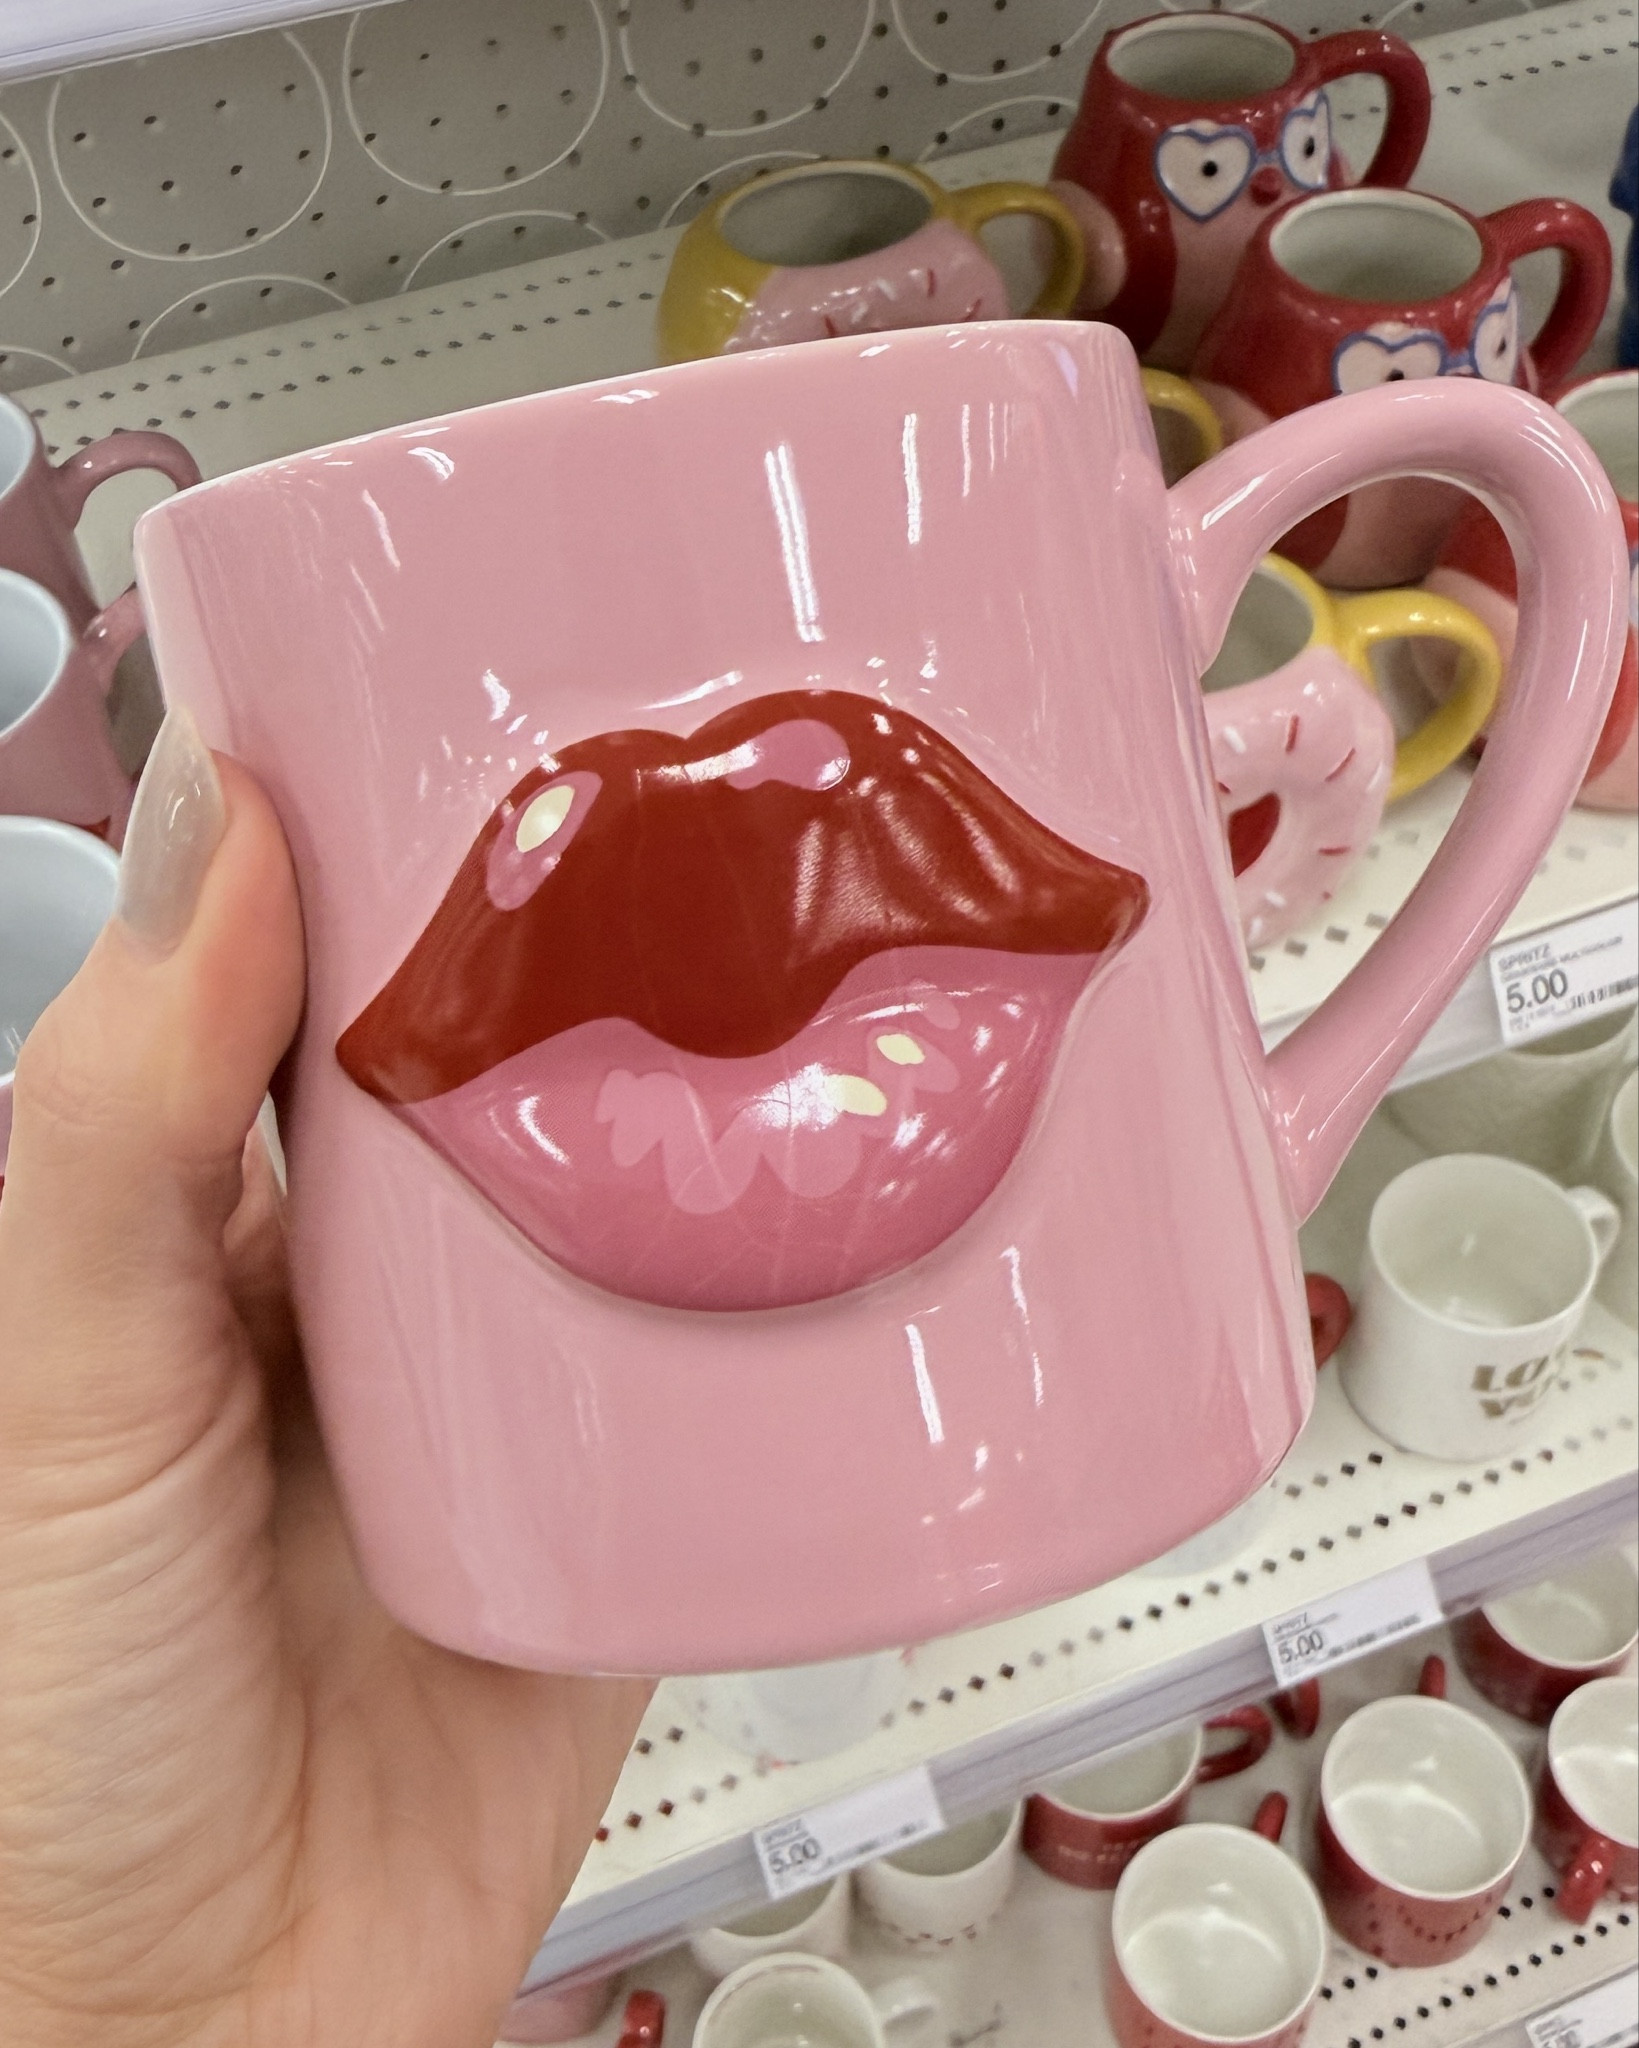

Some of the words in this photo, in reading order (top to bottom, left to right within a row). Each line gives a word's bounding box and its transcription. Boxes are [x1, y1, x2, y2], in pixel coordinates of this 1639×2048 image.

[1506, 968, 1568, 1013] 5.00
[1278, 1630, 1324, 1664] 5.00
[768, 1838, 821, 1874] 5.00
